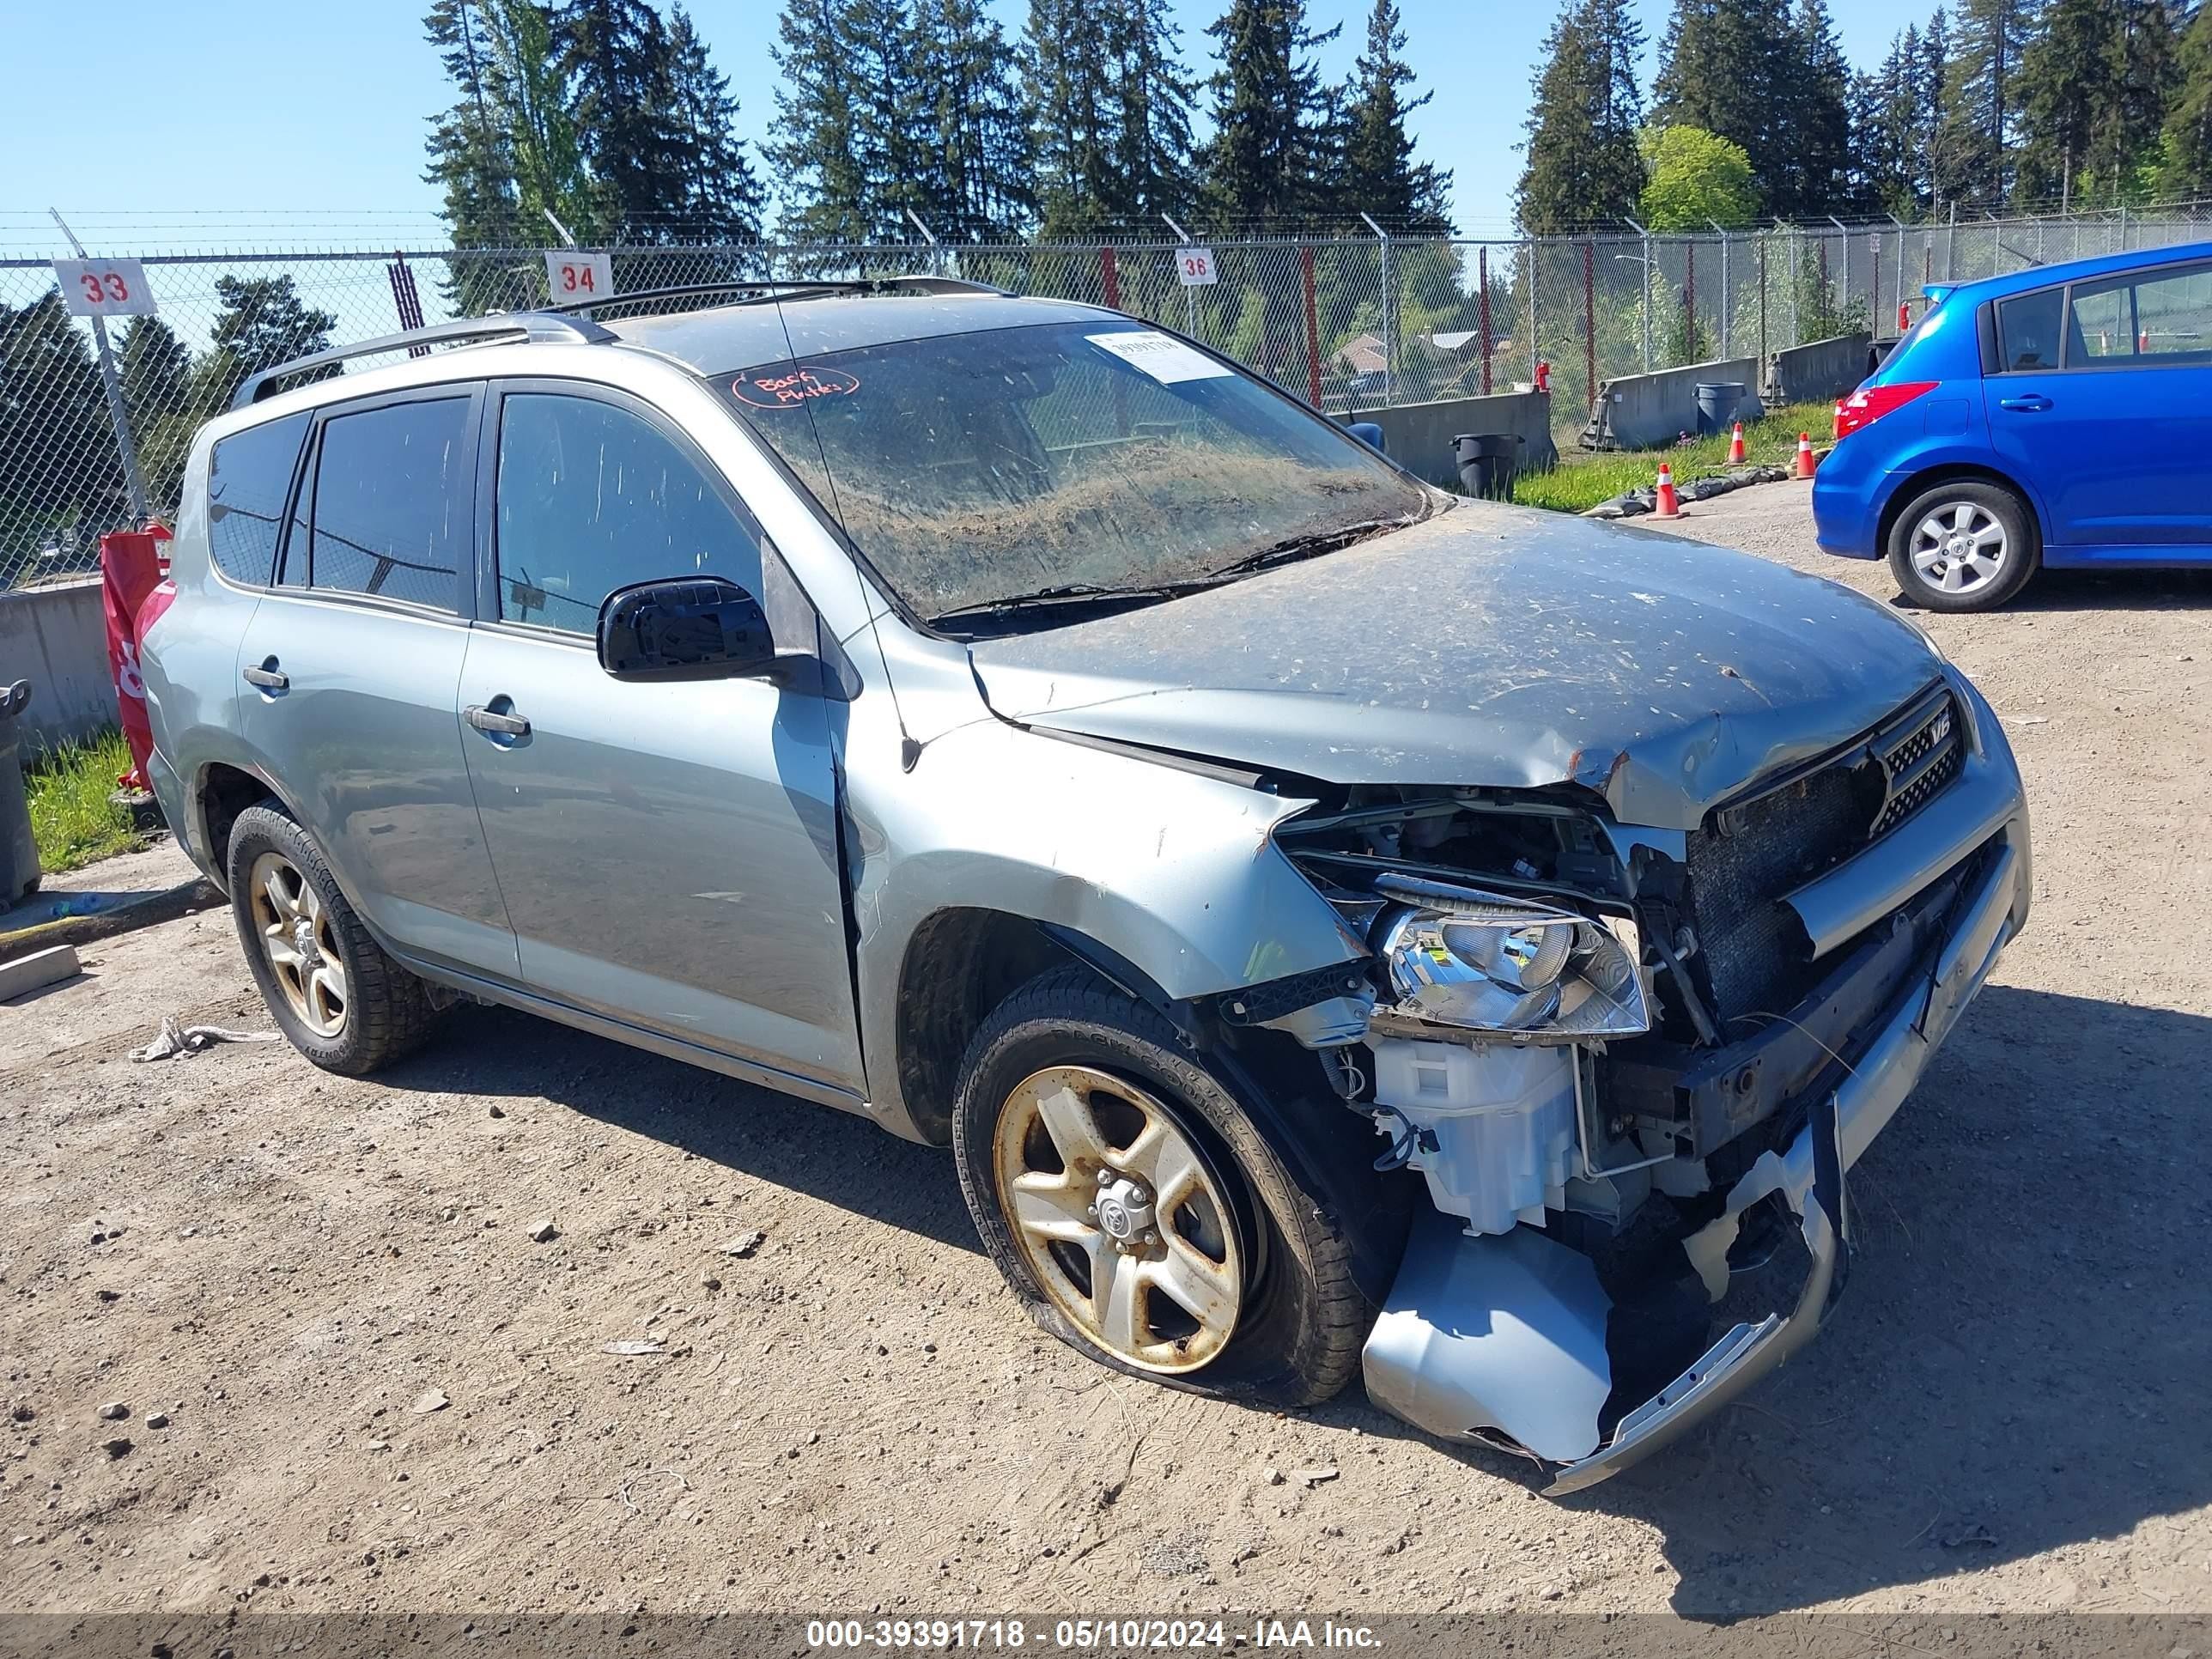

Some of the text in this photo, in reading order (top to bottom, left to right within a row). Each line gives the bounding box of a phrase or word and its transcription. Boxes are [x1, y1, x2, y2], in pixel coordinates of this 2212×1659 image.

[562, 266, 594, 292] 34
[1186, 258, 1206, 276] 36
[81, 273, 129, 302] 33
[1931, 714, 1951, 748] V6
